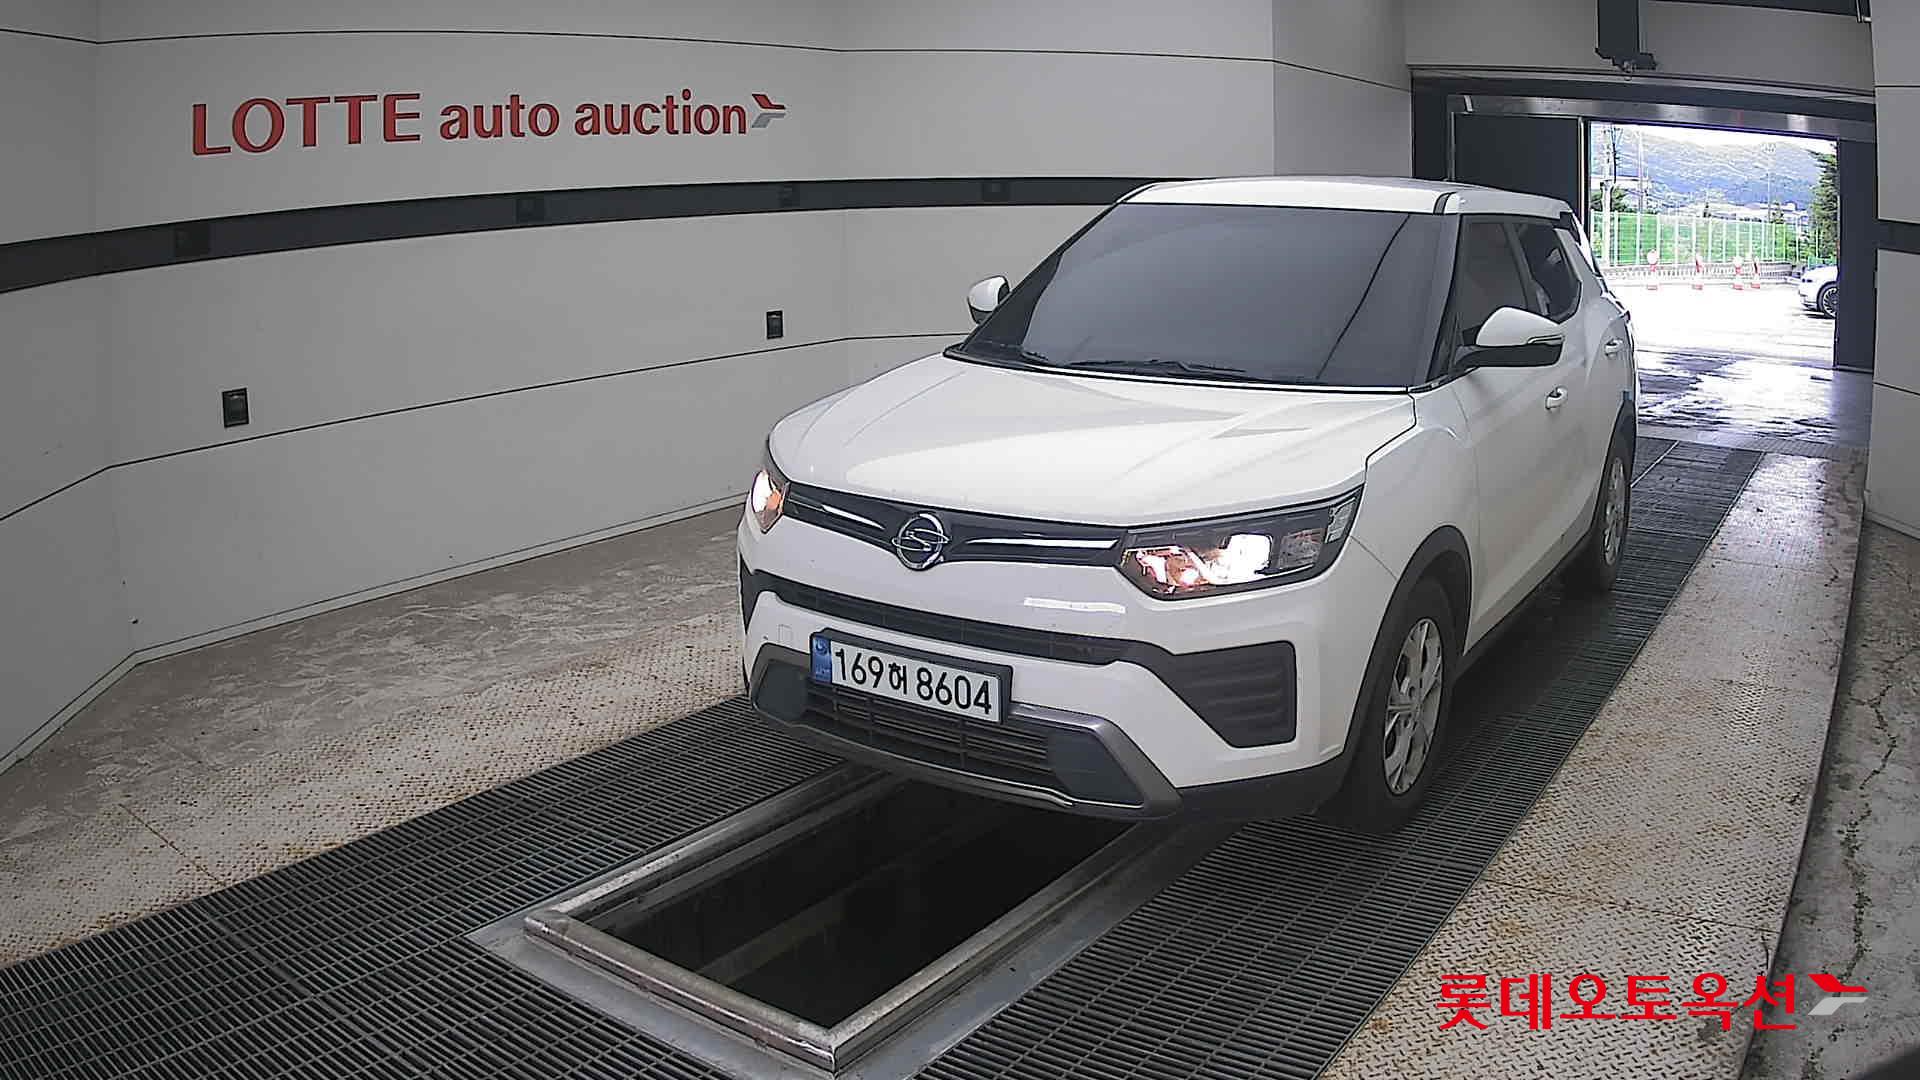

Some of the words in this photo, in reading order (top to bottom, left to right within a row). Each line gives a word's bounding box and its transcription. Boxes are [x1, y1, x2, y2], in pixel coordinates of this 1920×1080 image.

[192, 93, 421, 156] LOTTE
[439, 94, 560, 140] auto
[574, 88, 748, 136] auction
[835, 648, 908, 695] 169허
[916, 667, 992, 714] 8604
